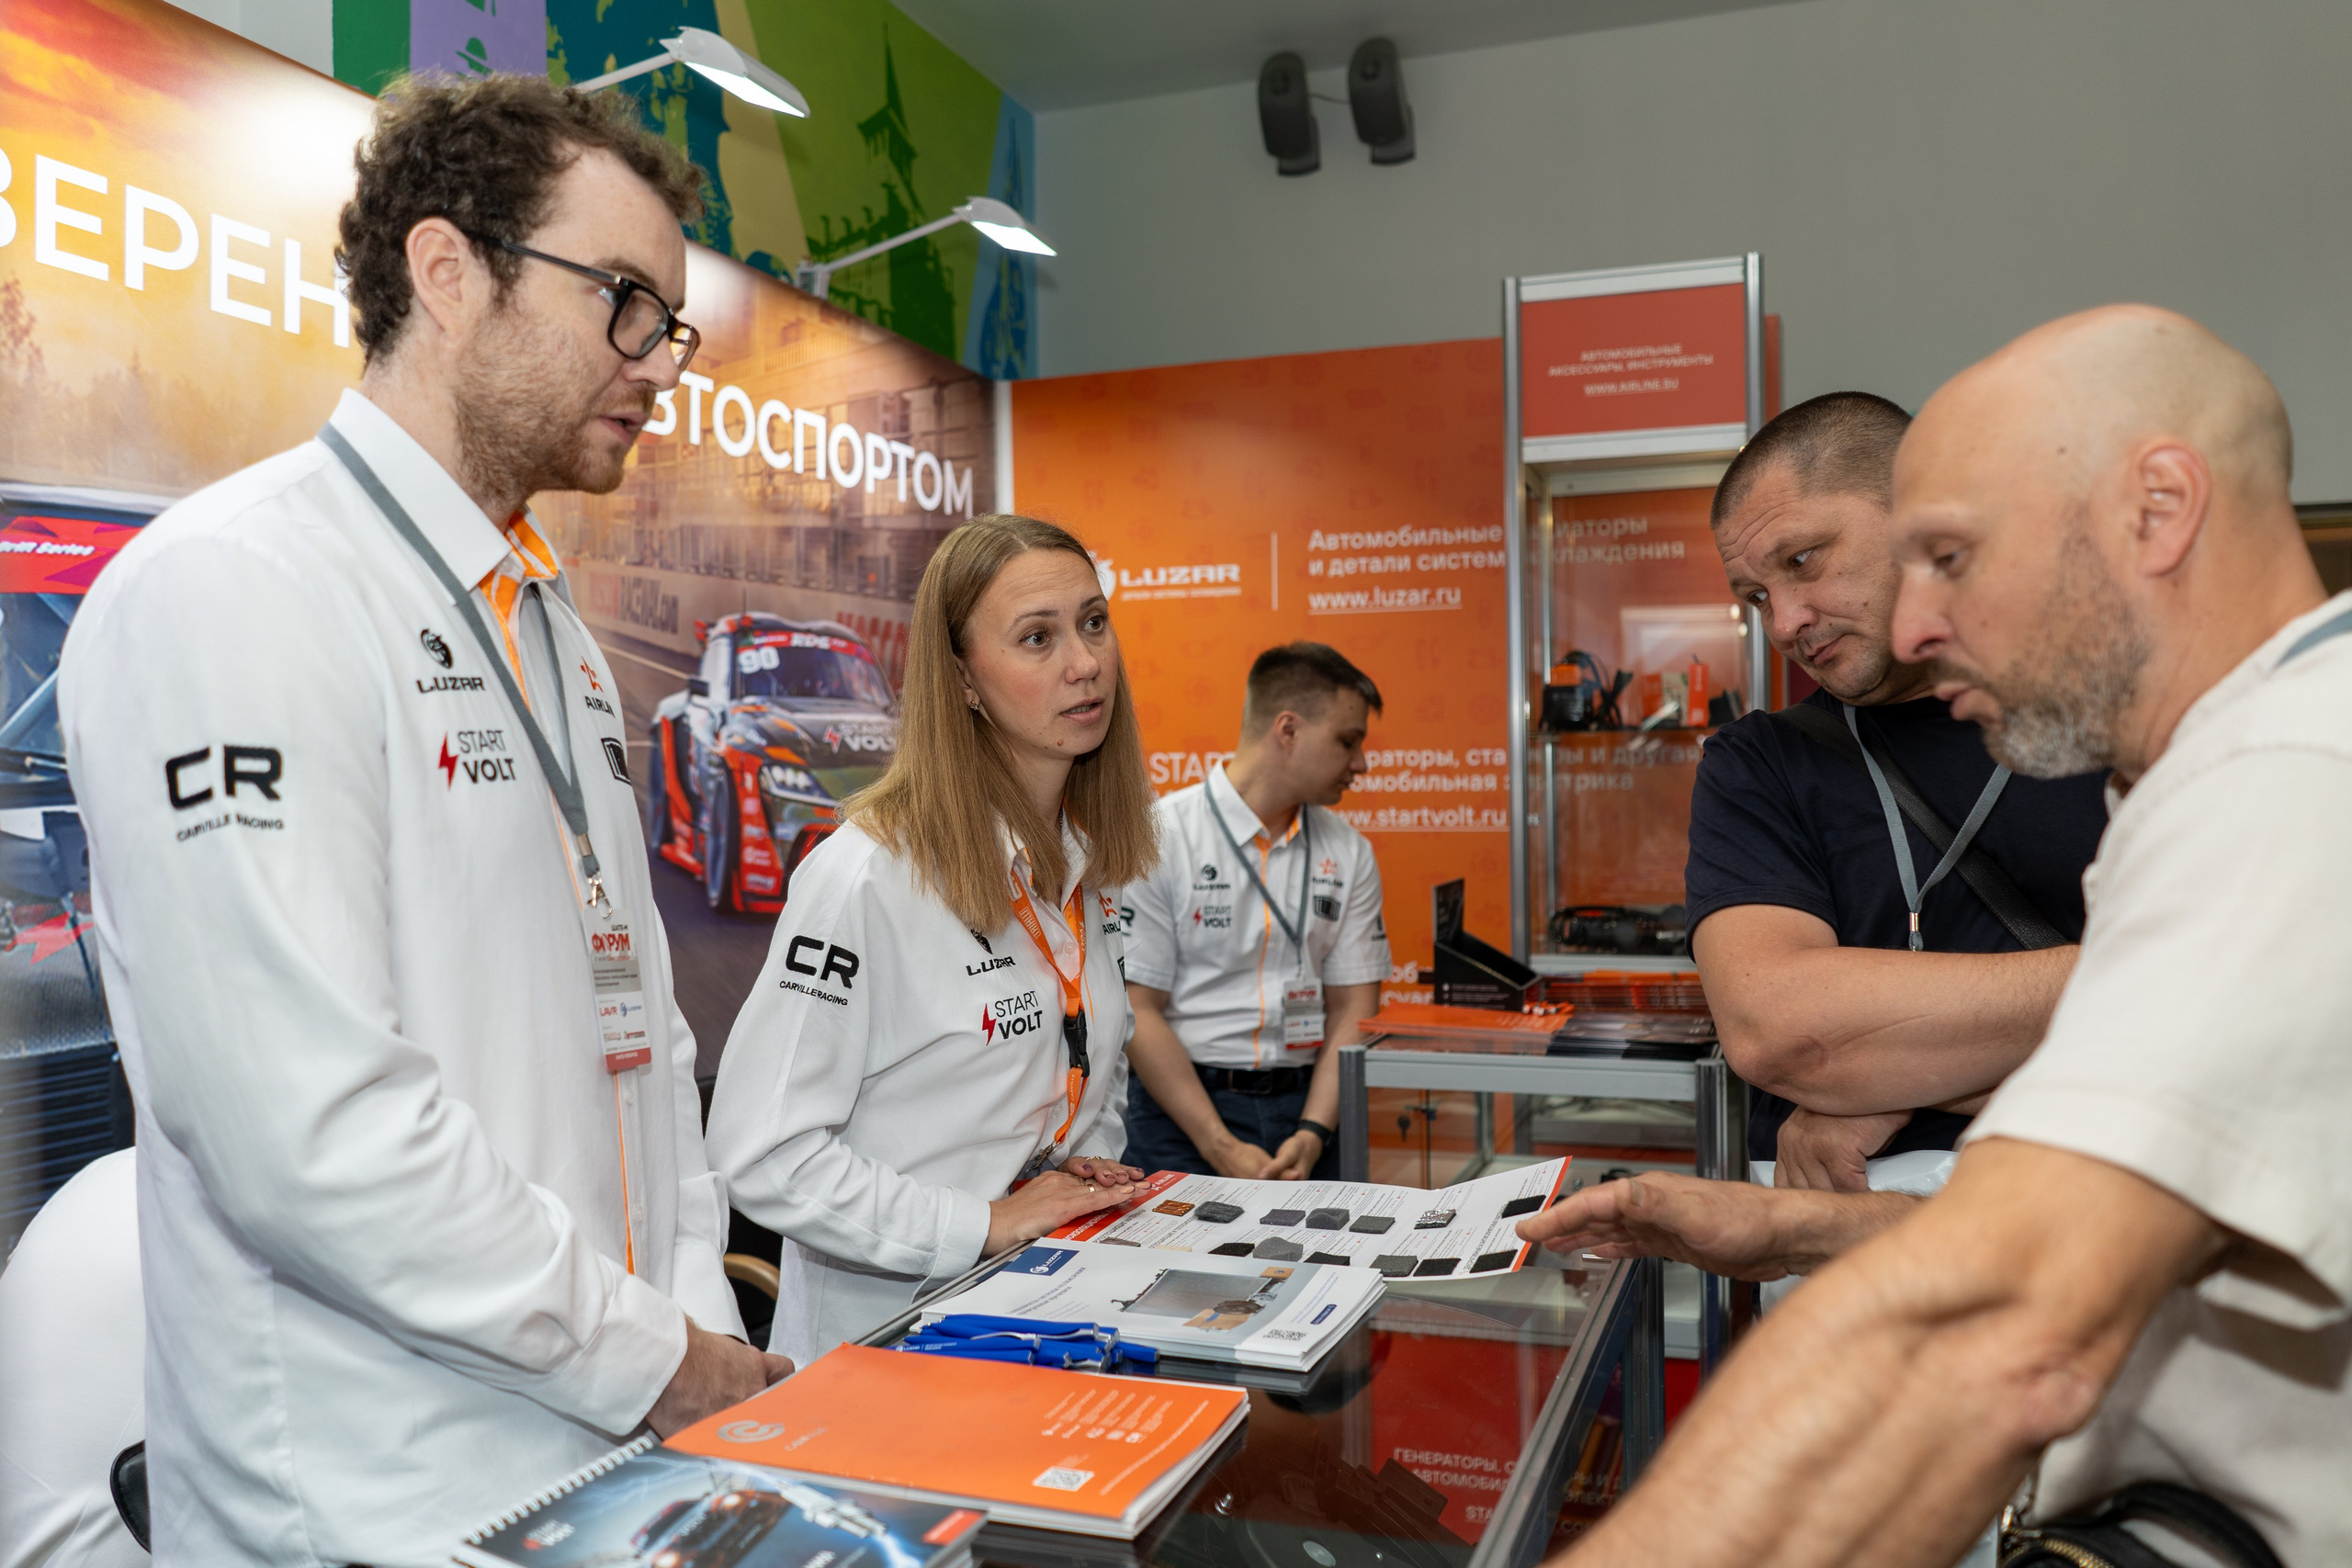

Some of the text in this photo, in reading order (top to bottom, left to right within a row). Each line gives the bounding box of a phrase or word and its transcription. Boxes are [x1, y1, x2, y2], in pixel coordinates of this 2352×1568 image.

[1308, 525, 1504, 552] Автомобильные
[1120, 564, 1240, 587] LUZAR
[1309, 559, 1323, 576] и
[1329, 556, 1411, 579] детали
[1416, 549, 1507, 571] систем
[1308, 585, 1462, 610] www.luzar.ru
[738, 646, 780, 674] 90
[416, 676, 486, 694] LUZAR
[458, 730, 507, 753] START
[462, 758, 516, 784] VOLT
[1365, 748, 1460, 773] раторы,
[165, 744, 282, 811] CR
[1351, 770, 1498, 794] омобильная
[176, 813, 284, 842] CARVILLE RACING
[1203, 918, 1233, 929] VOLT
[786, 935, 860, 990] CR
[967, 956, 1016, 976] LUZAR
[815, 990, 849, 1006] RACING
[994, 990, 1039, 1018] START
[998, 1010, 1043, 1040] VOLT
[1393, 1447, 1502, 1473] ГЕНЕРАТОРЫ,
